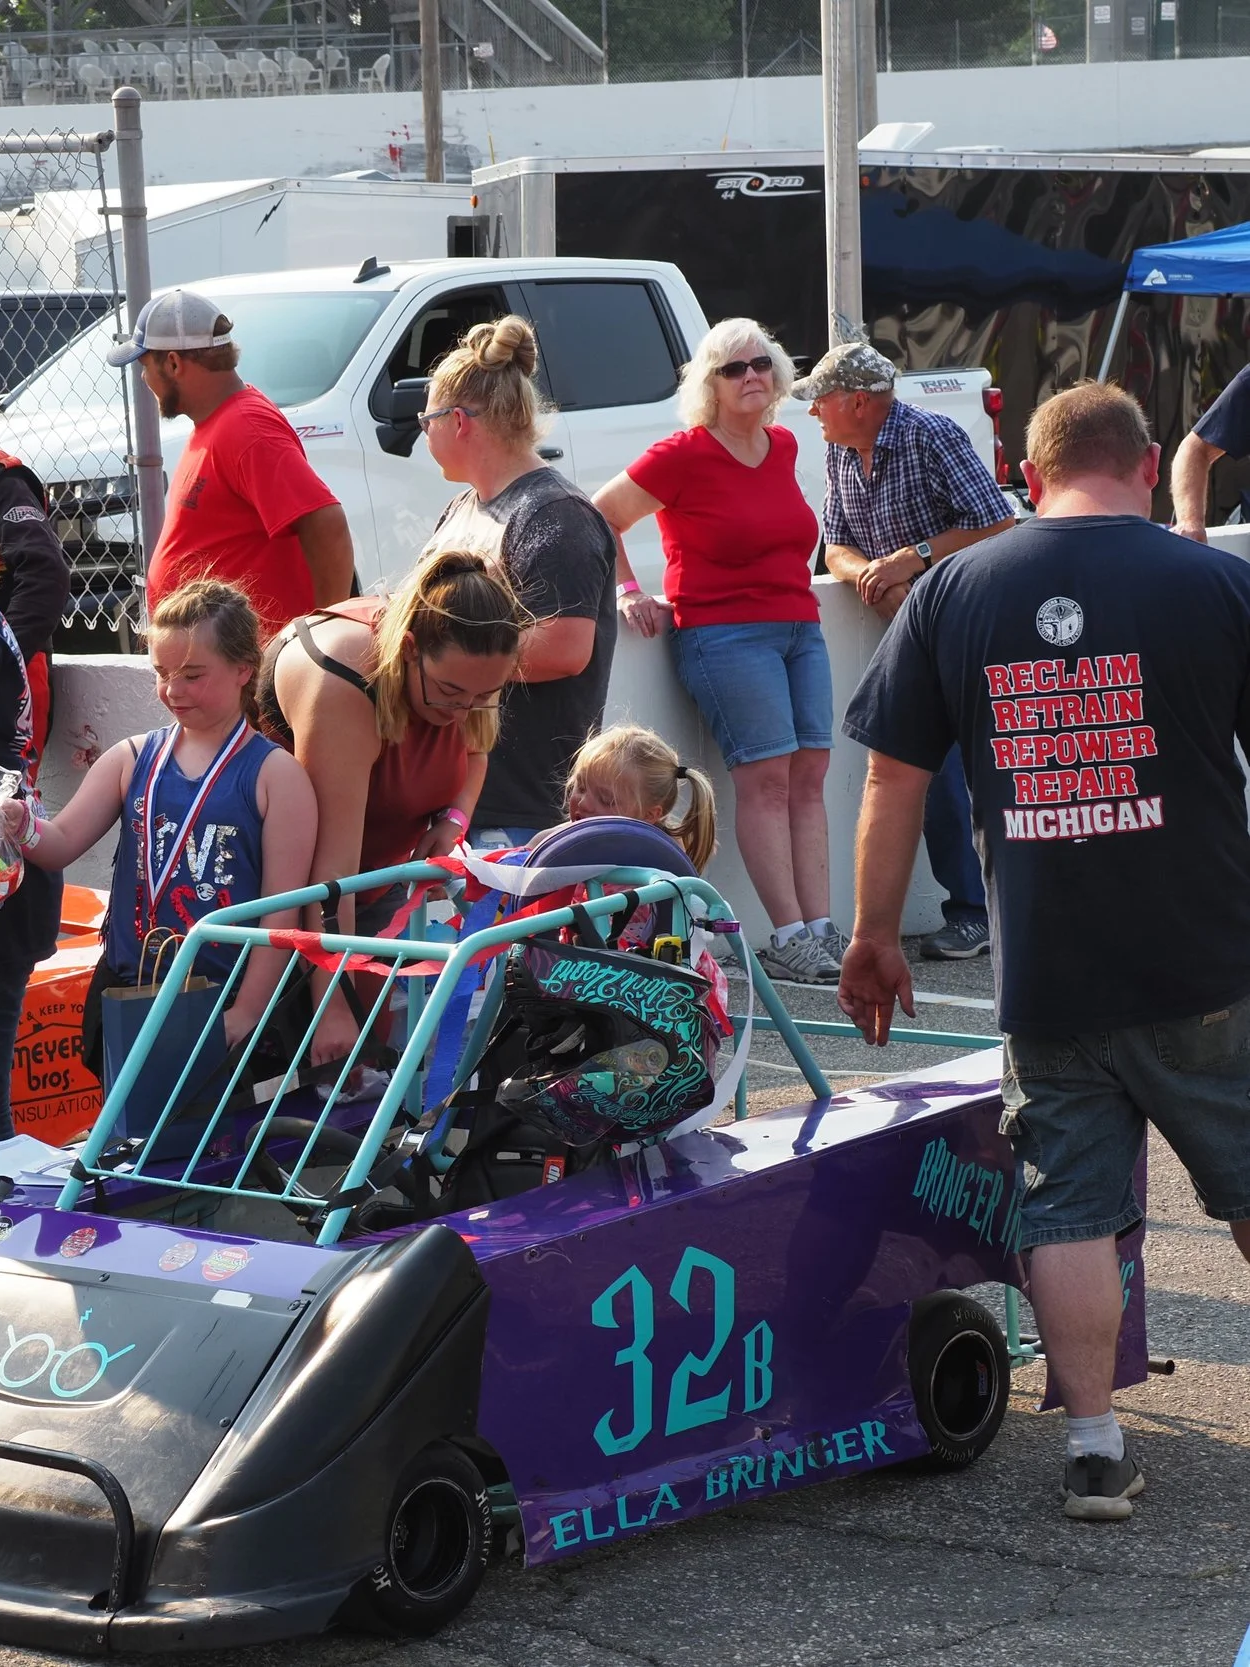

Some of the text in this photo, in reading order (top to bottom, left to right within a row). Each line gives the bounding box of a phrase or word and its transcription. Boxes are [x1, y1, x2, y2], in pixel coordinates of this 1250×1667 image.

[721, 190, 736, 200] 44
[914, 378, 966, 388] TRAIL
[924, 386, 962, 394] BOSS
[984, 653, 1143, 697] RECLAIM
[992, 689, 1144, 732] RETRAIN
[990, 726, 1158, 769] REPOWER
[1013, 765, 1138, 804] REPAIR
[1003, 796, 1164, 840] MICHIGAN
[39, 1004, 66, 1017] KEEP
[28, 1069, 75, 1092] bros.
[549, 1420, 896, 1550] ELLA BRINGER
